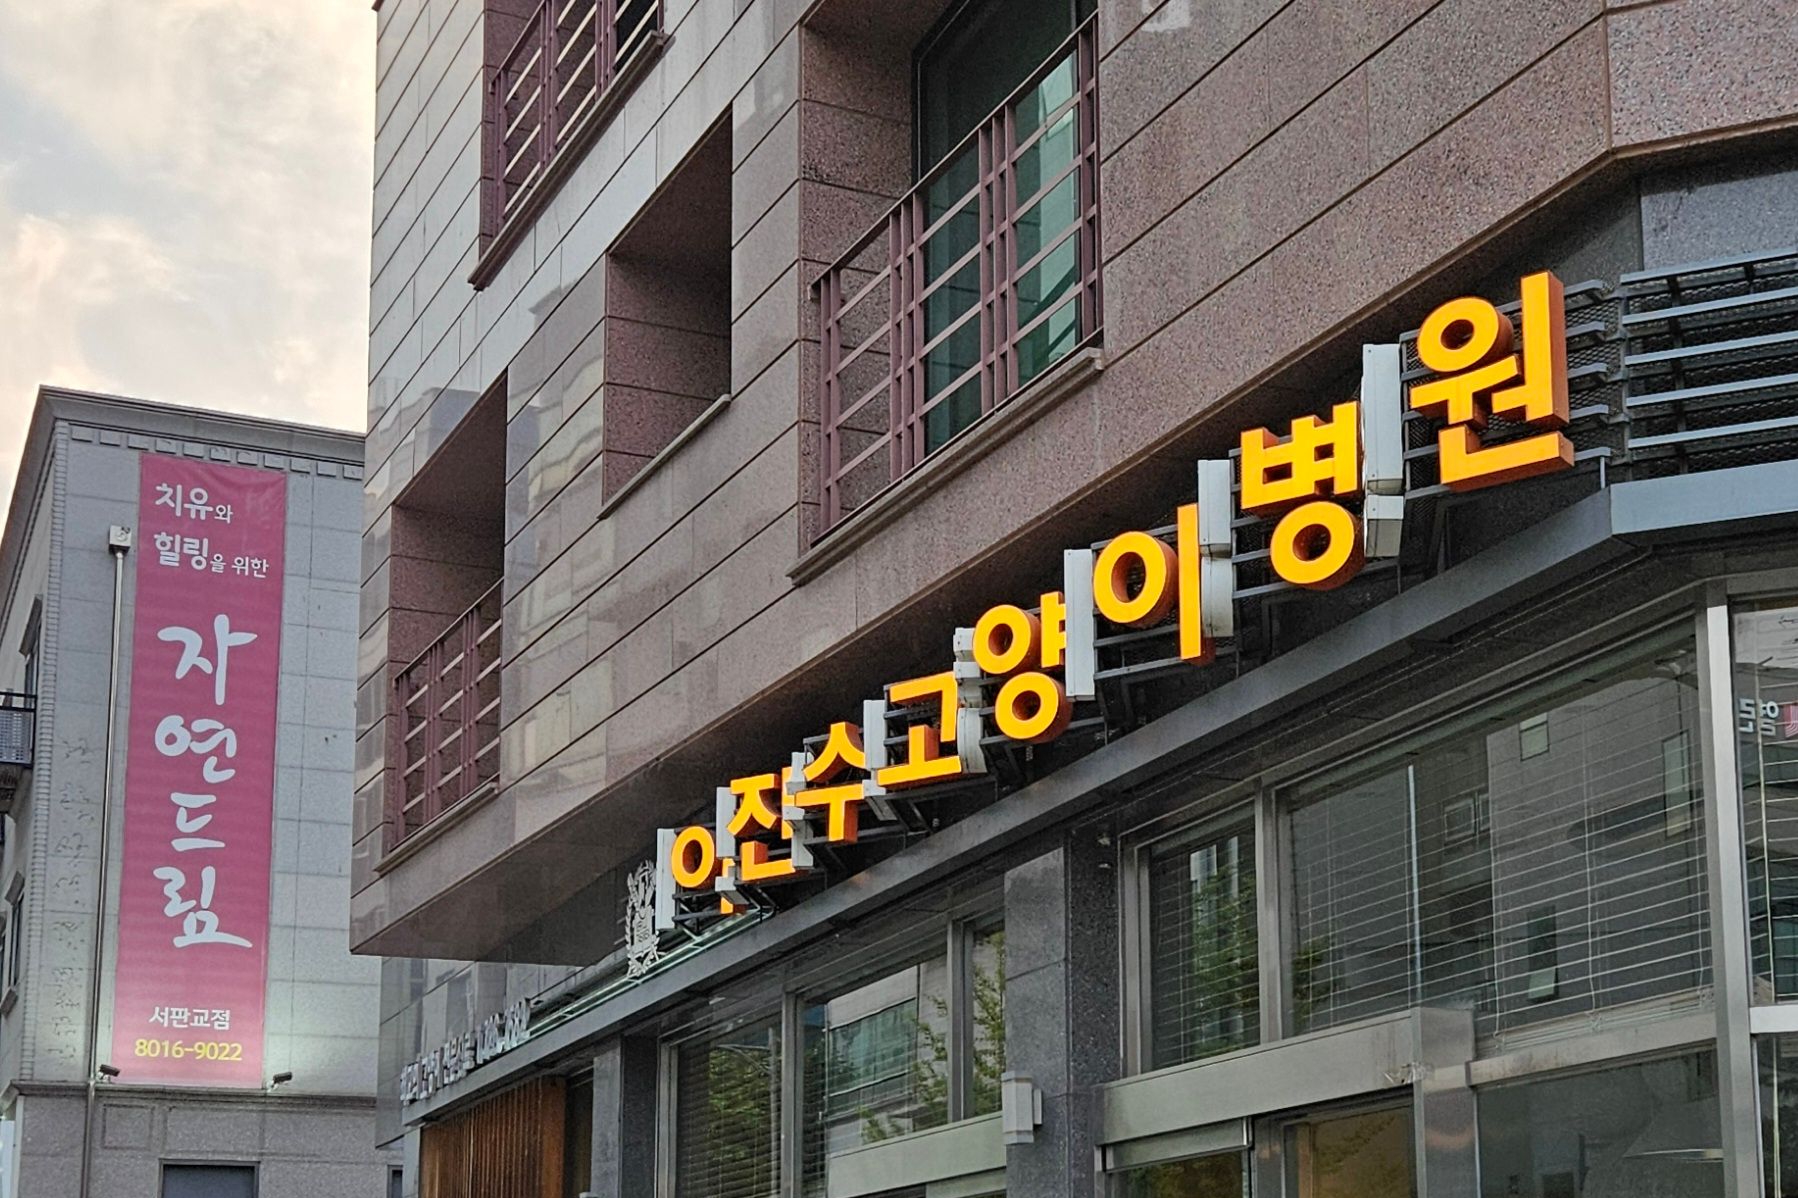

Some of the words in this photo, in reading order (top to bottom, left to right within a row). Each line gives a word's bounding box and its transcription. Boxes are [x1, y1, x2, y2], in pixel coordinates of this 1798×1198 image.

[155, 483, 234, 524] 치유와
[154, 532, 227, 573] 힐링을
[231, 557, 270, 578] 위한
[153, 613, 258, 949] 자연드림
[149, 1006, 231, 1030] 서판교점
[134, 1039, 243, 1061] 8016-9022
